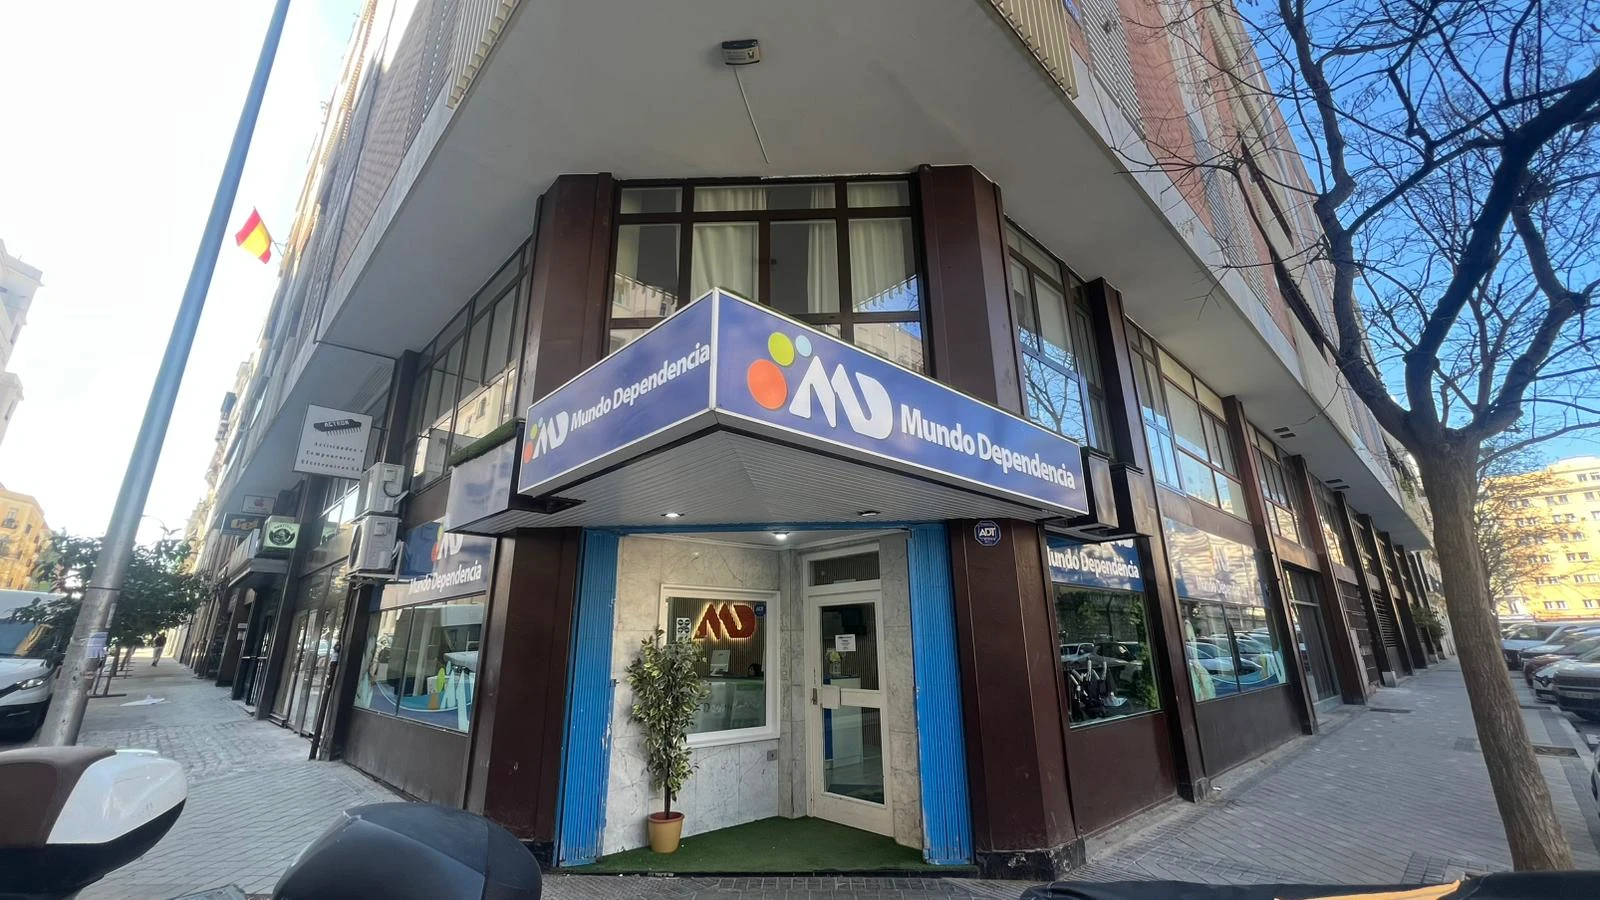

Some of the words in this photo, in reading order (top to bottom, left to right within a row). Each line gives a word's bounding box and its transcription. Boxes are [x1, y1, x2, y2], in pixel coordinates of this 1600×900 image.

[570, 395, 612, 433] Mundo
[612, 341, 710, 410] Dependencia
[900, 403, 976, 456] Mundo
[977, 432, 1076, 490] Dependencia
[979, 527, 996, 537] ADT
[431, 559, 483, 593] Dependencia
[1080, 551, 1140, 579] Dependencia
